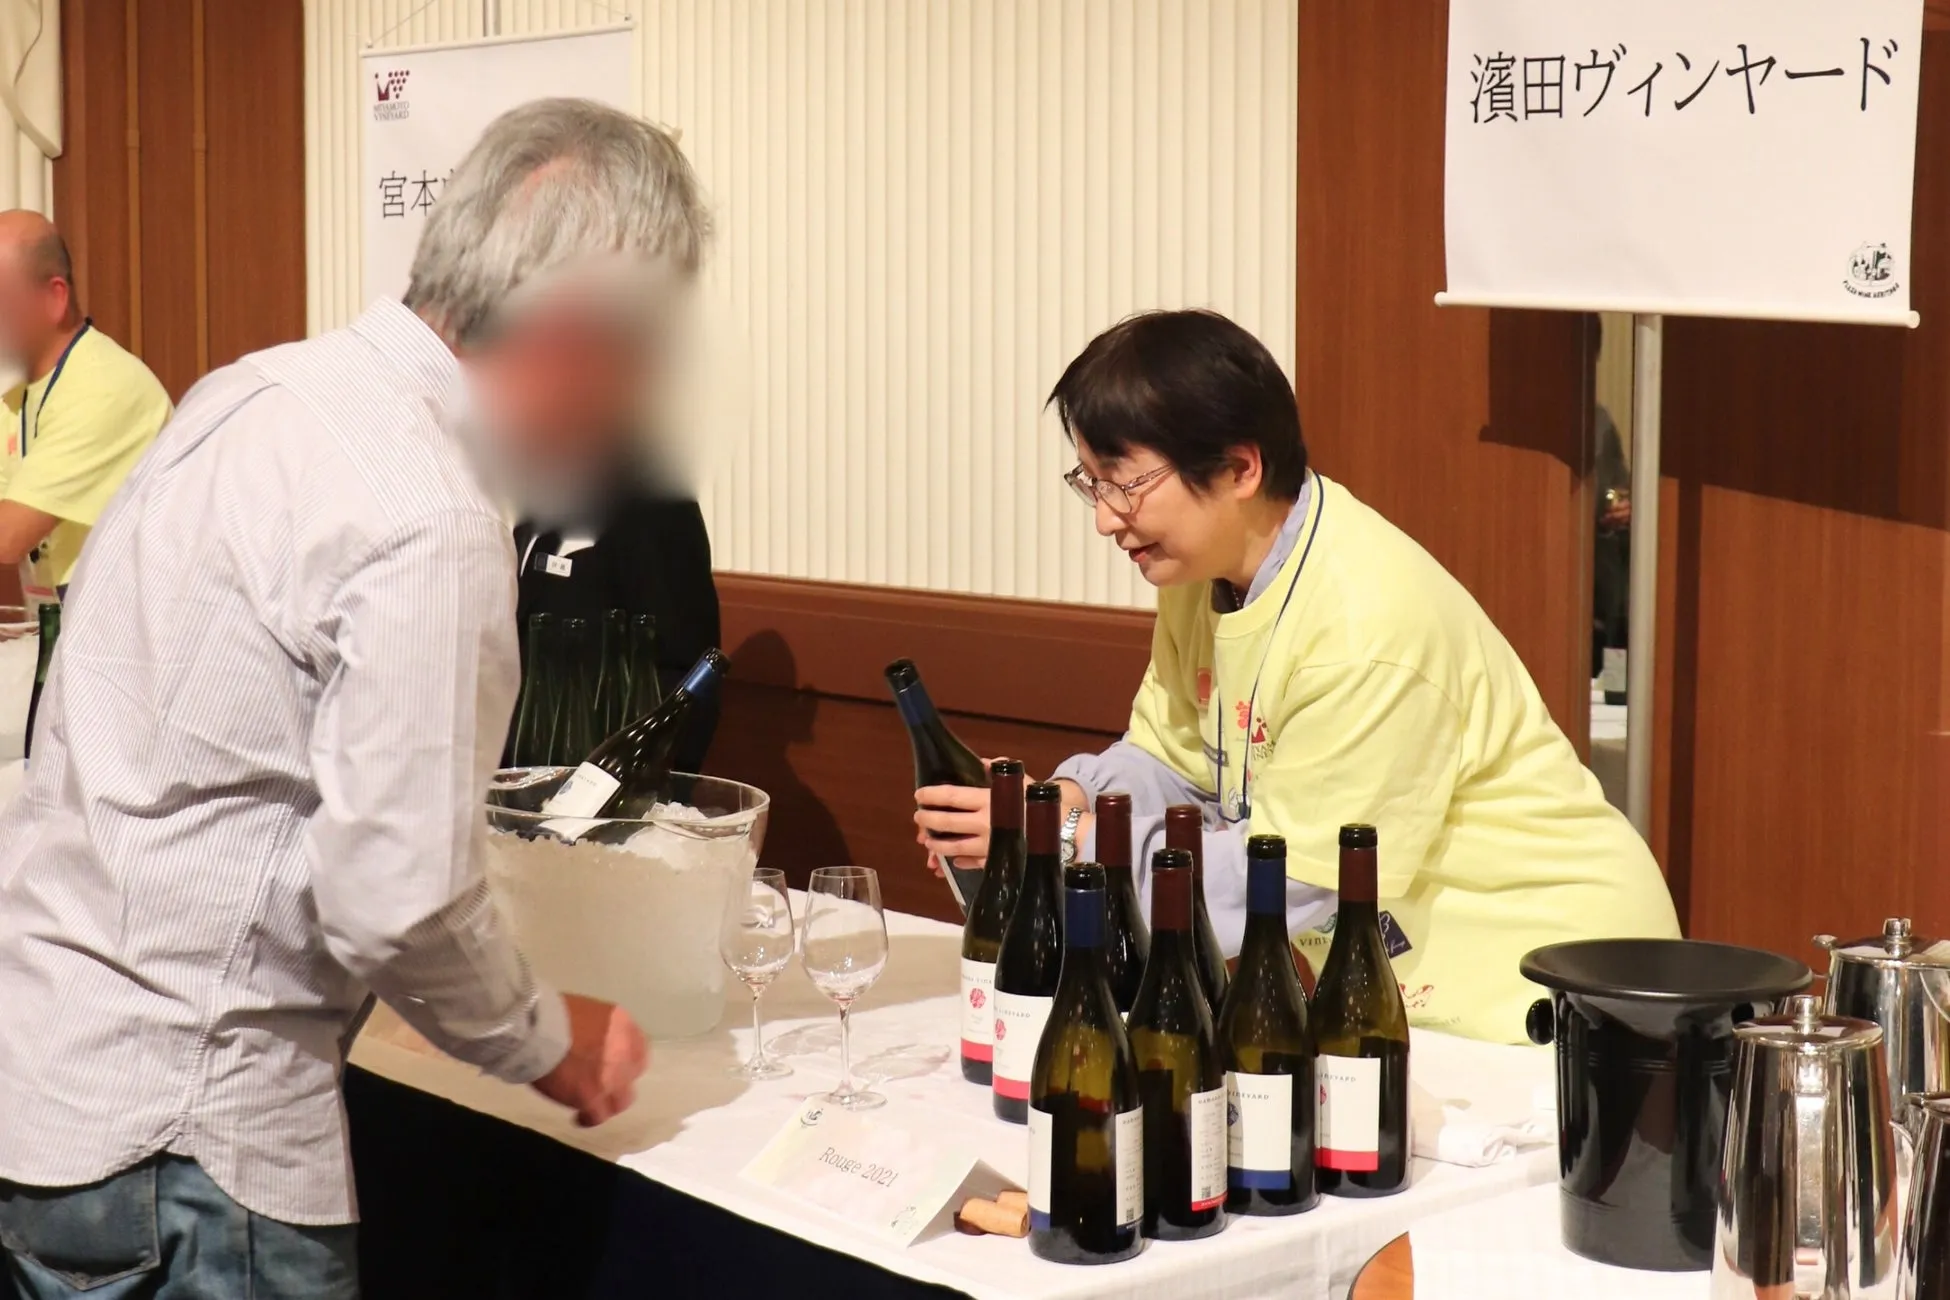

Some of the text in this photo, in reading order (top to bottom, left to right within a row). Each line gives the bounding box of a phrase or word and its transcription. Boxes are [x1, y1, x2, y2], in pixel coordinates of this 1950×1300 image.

[1470, 37, 1899, 124] 濱田ヴィンヤード
[378, 168, 455, 219] 宮本
[818, 1146, 899, 1188] Rouge 2021
